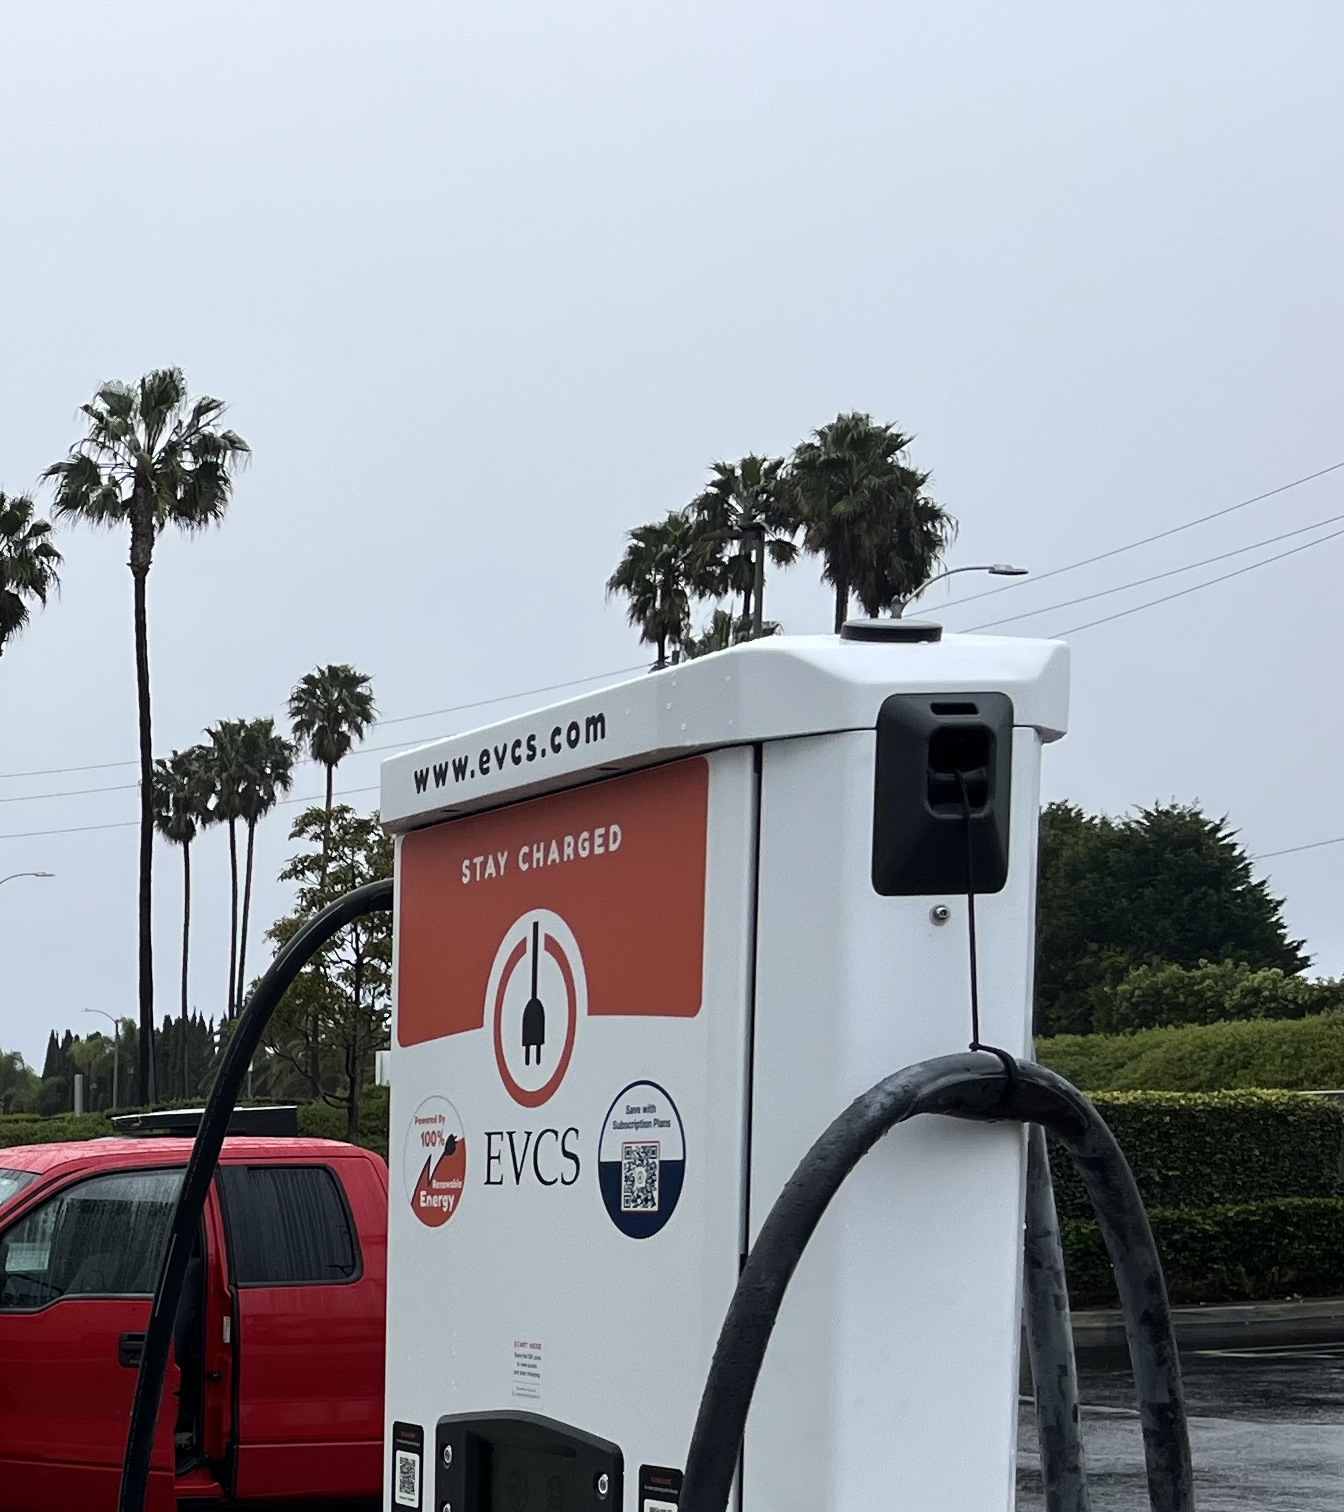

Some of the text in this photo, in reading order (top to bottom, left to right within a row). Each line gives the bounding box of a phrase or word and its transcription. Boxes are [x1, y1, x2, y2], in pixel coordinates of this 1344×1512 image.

[413, 712, 606, 795] www.evcs.com
[461, 824, 622, 885] STAY CHARGED
[414, 1114, 438, 1125] Powered
[625, 1103, 657, 1115] Save with
[612, 1118, 652, 1132] Subscription
[420, 1128, 445, 1148] 100%
[483, 1127, 581, 1186] EVCS
[419, 1190, 455, 1212] Energy
